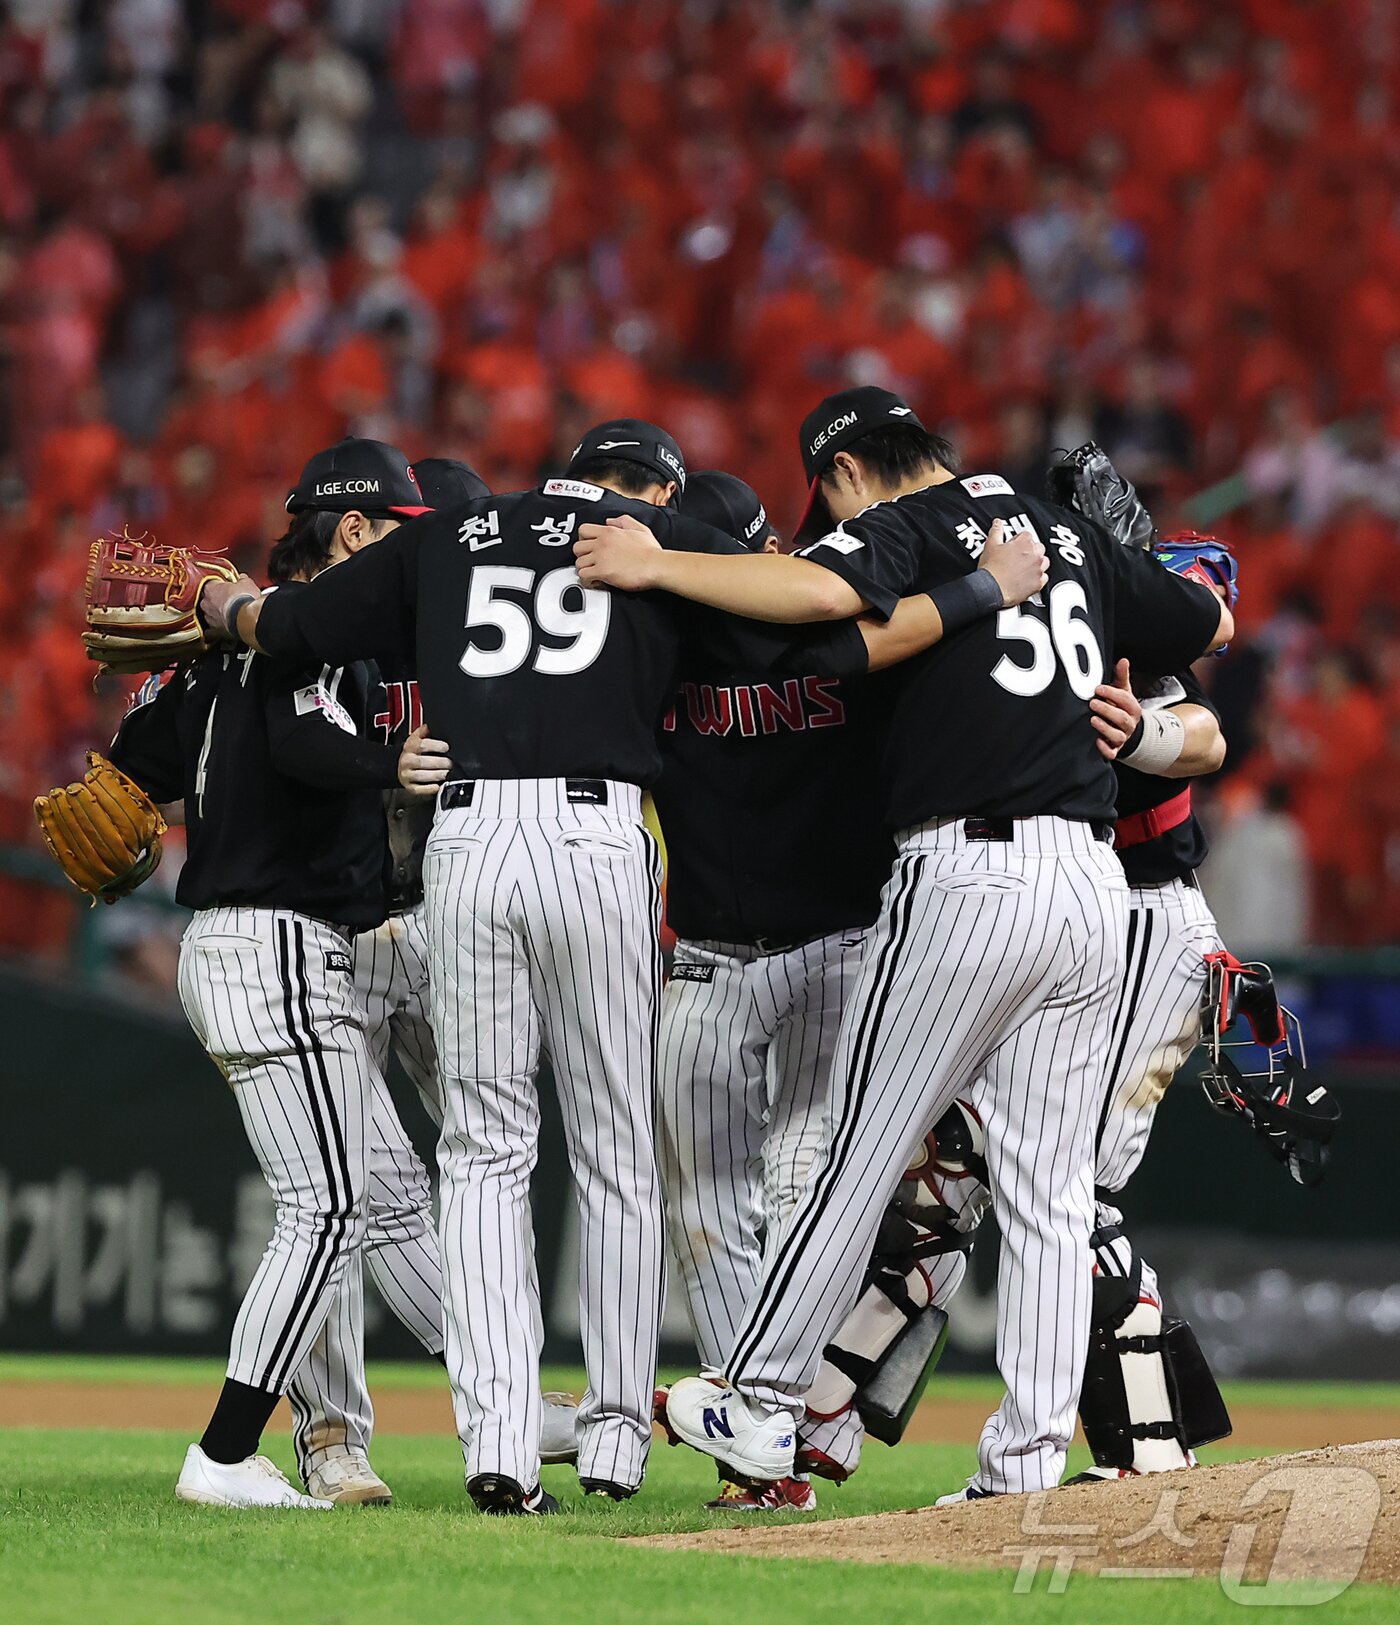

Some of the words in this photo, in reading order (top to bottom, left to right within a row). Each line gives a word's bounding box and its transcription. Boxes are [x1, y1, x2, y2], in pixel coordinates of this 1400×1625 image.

[809, 410, 858, 456] LGE.COM
[316, 480, 379, 496] LGE.COM
[564, 484, 581, 493] LG
[981, 480, 996, 489] LG
[458, 510, 576, 552] 천성
[457, 565, 612, 678] 59
[990, 580, 1104, 701] 56
[703, 1407, 736, 1439] N
